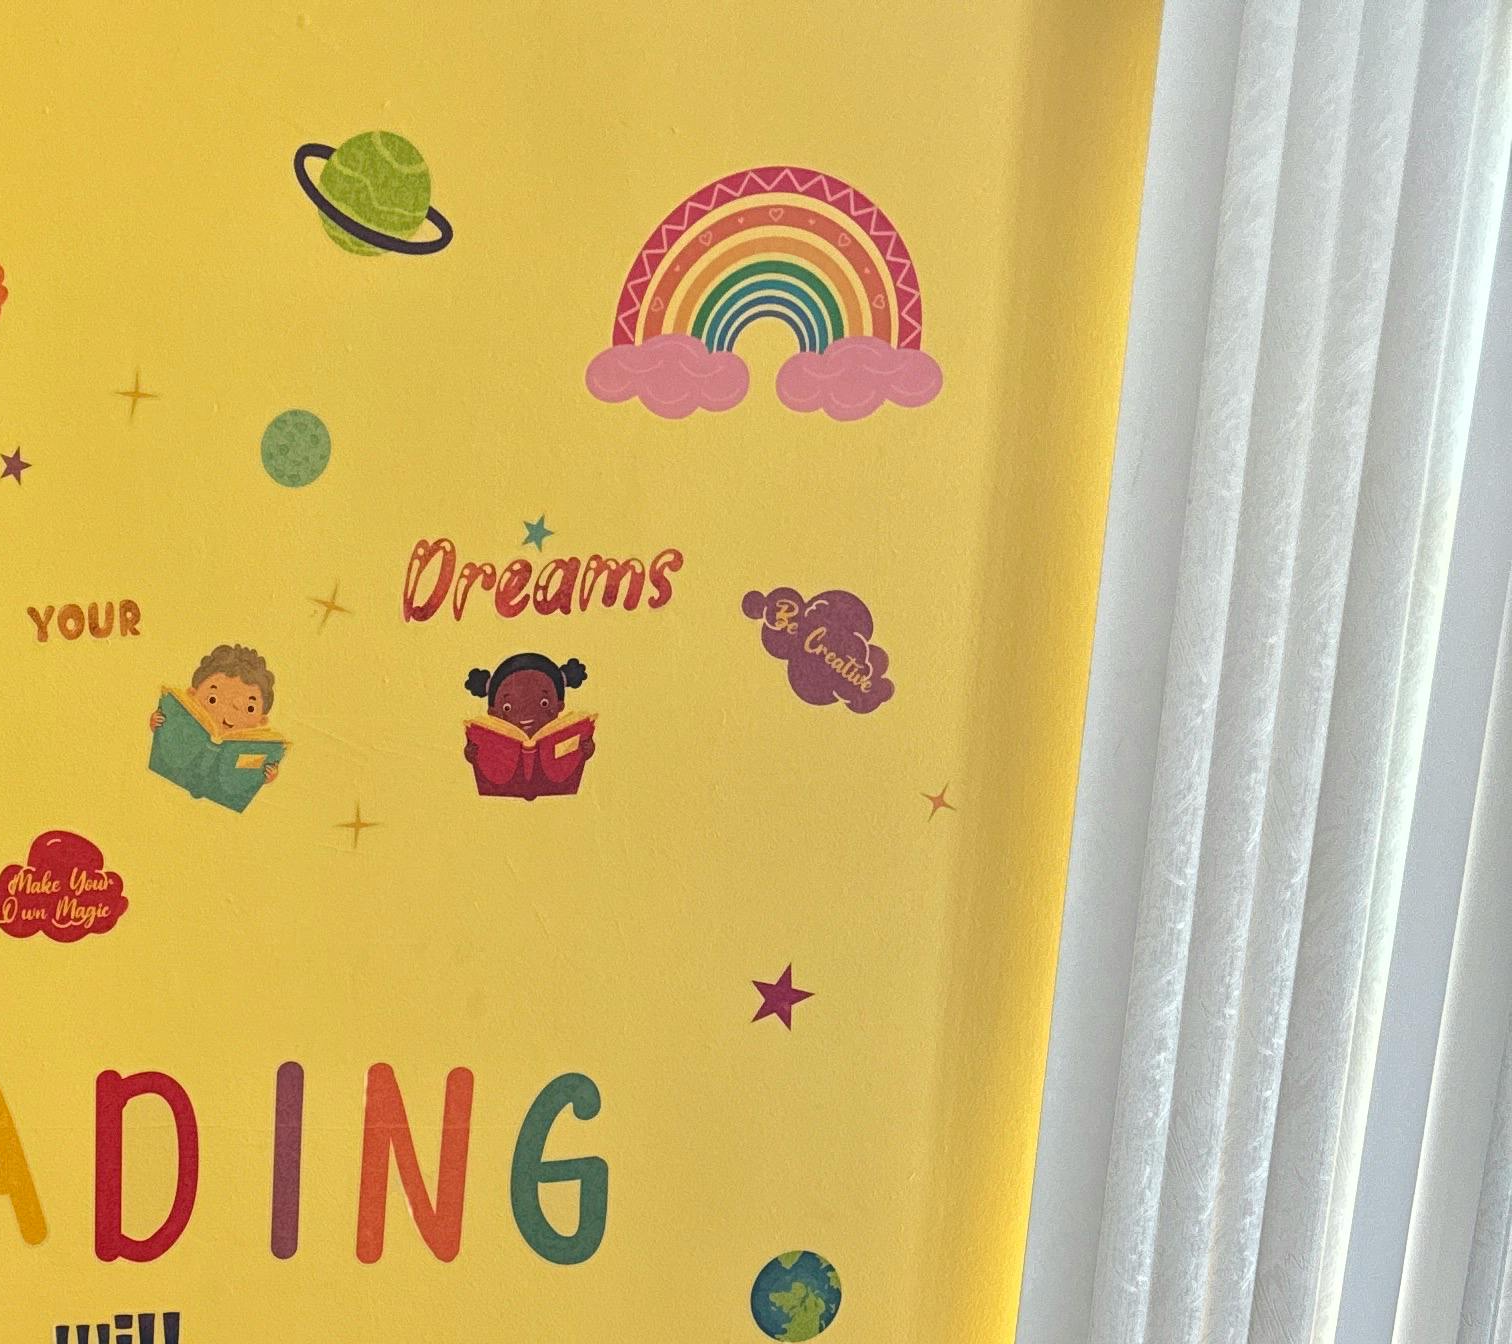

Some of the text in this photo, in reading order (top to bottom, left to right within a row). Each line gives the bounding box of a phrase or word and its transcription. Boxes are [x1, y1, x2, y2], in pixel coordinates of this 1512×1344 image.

[402, 537, 684, 623] Dreams
[27, 600, 141, 642] YOUR
[774, 600, 872, 693] Be Creative
[8, 867, 114, 896] Make Your
[55, 896, 112, 928] Magic
